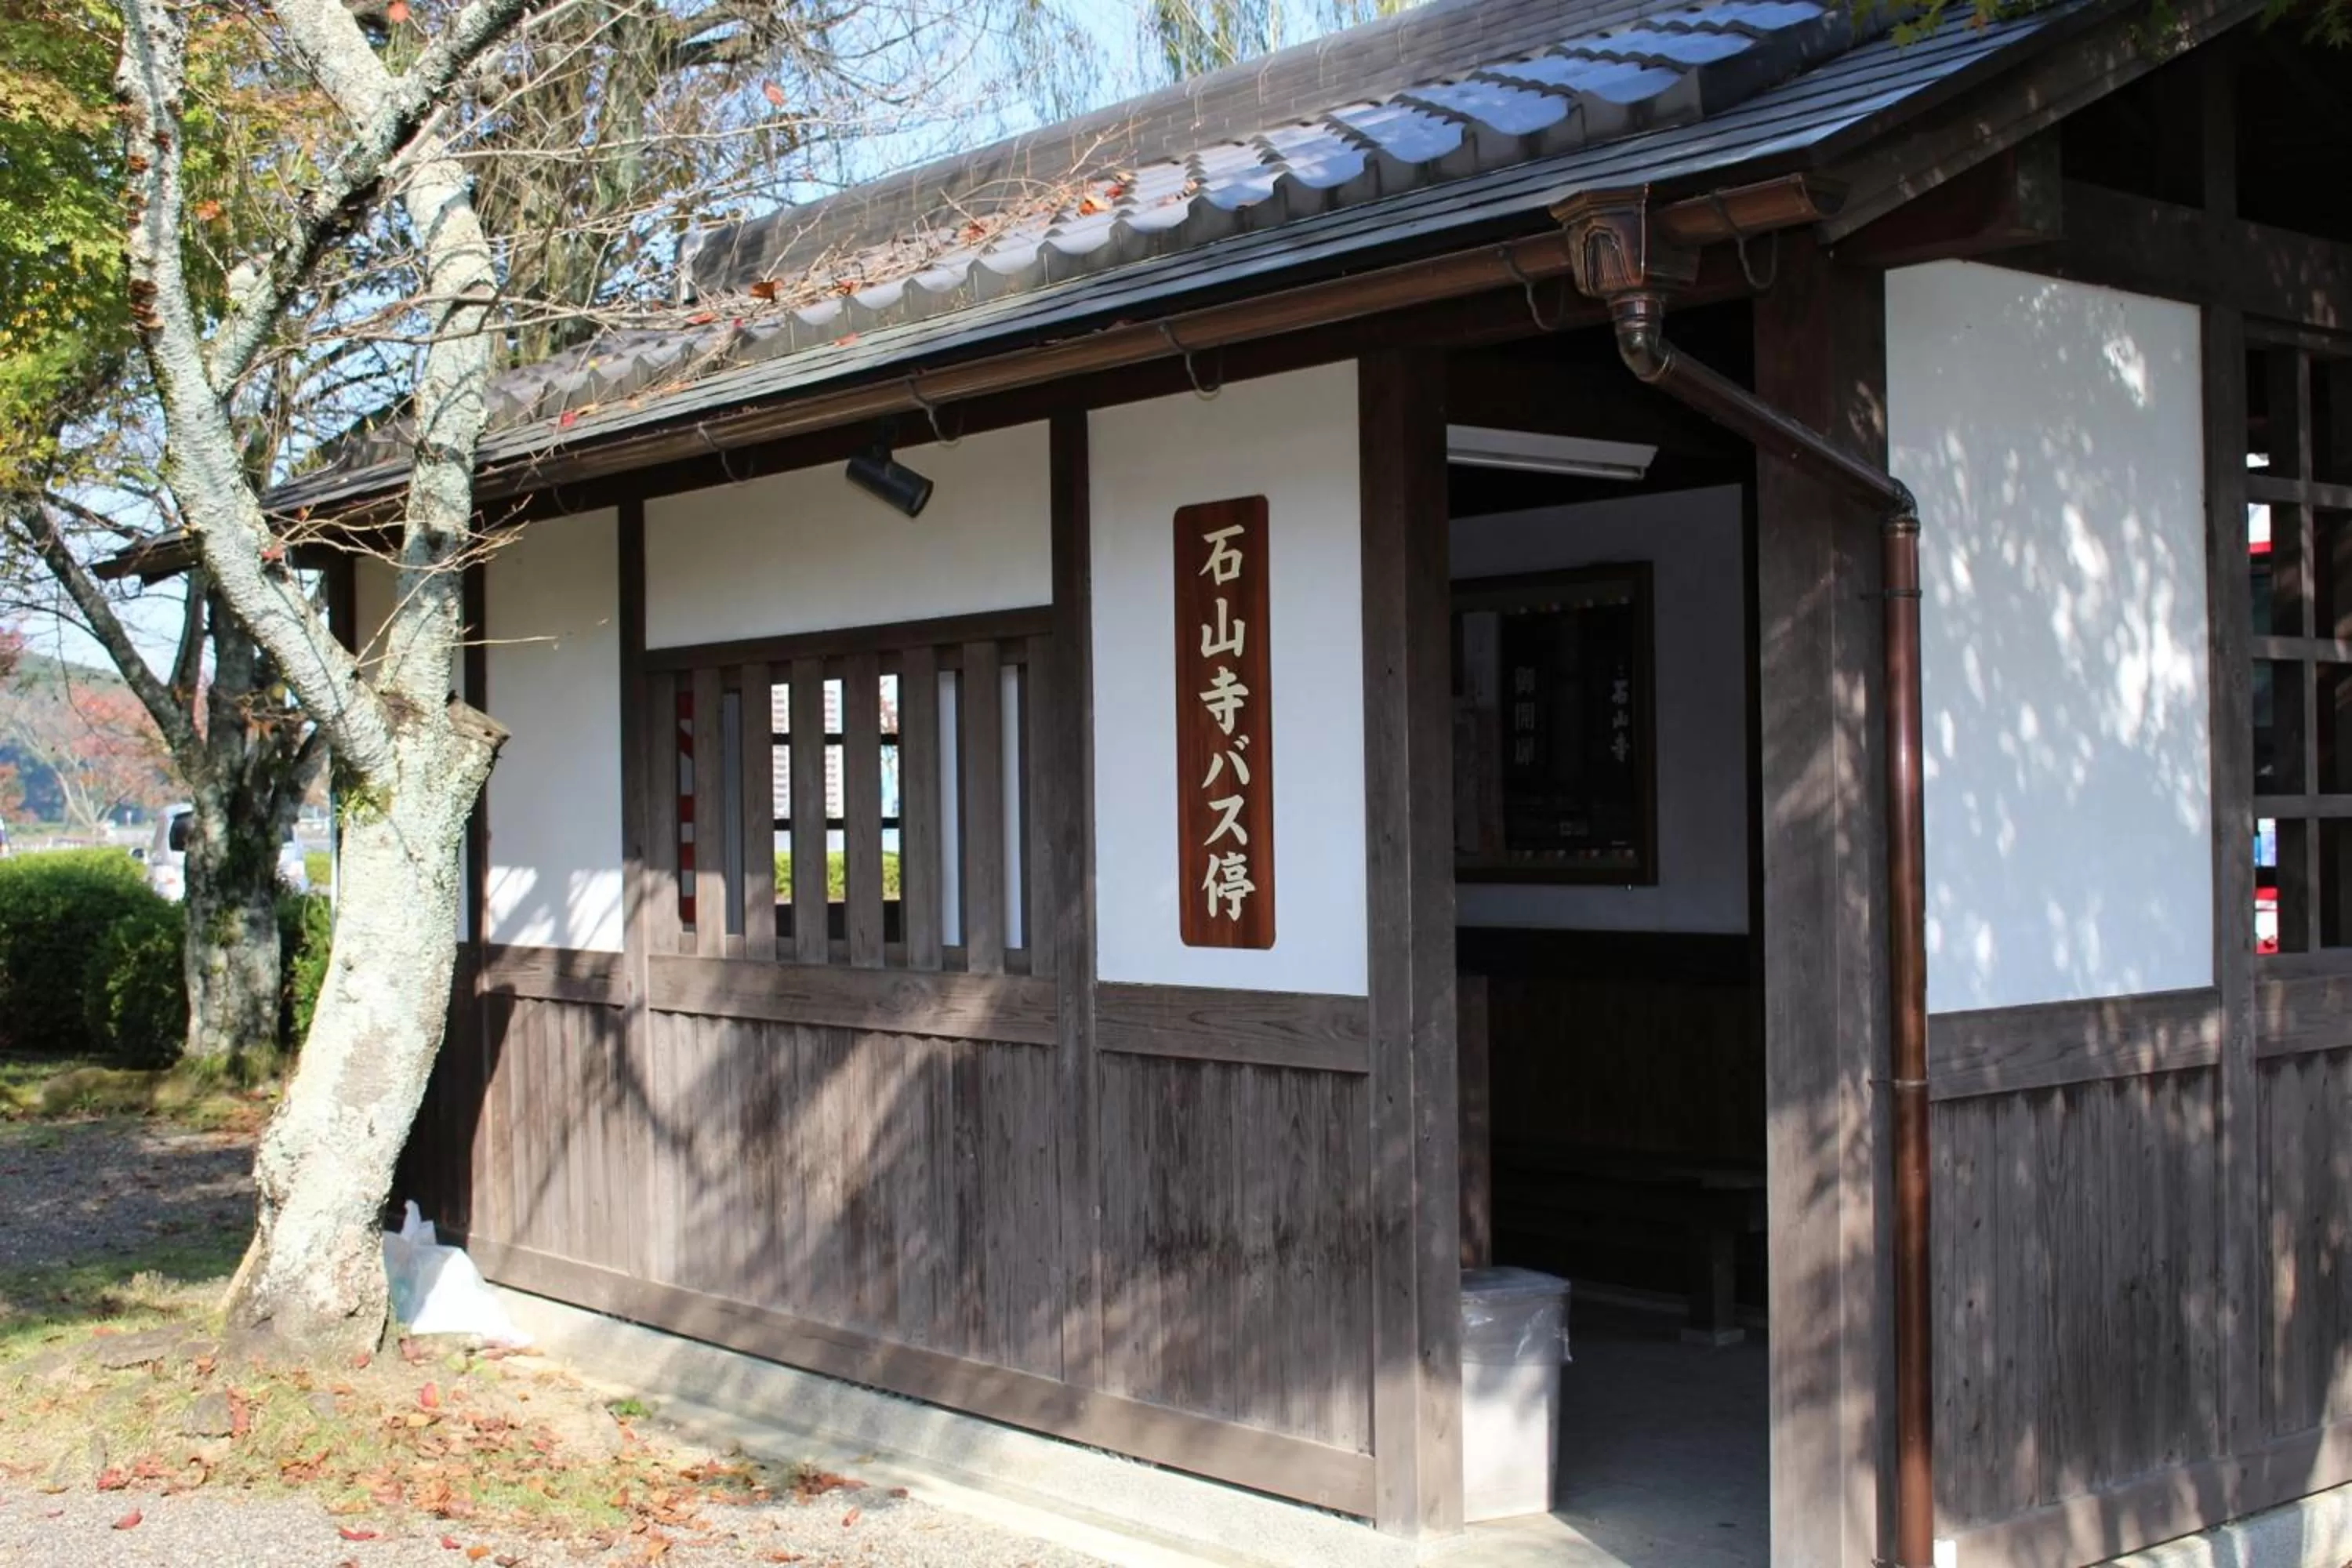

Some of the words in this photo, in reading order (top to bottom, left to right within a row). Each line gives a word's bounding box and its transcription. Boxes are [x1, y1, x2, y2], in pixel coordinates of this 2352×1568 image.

[1199, 524, 1254, 921] 石山寺バス停
[1610, 678, 1631, 763] 石山寺
